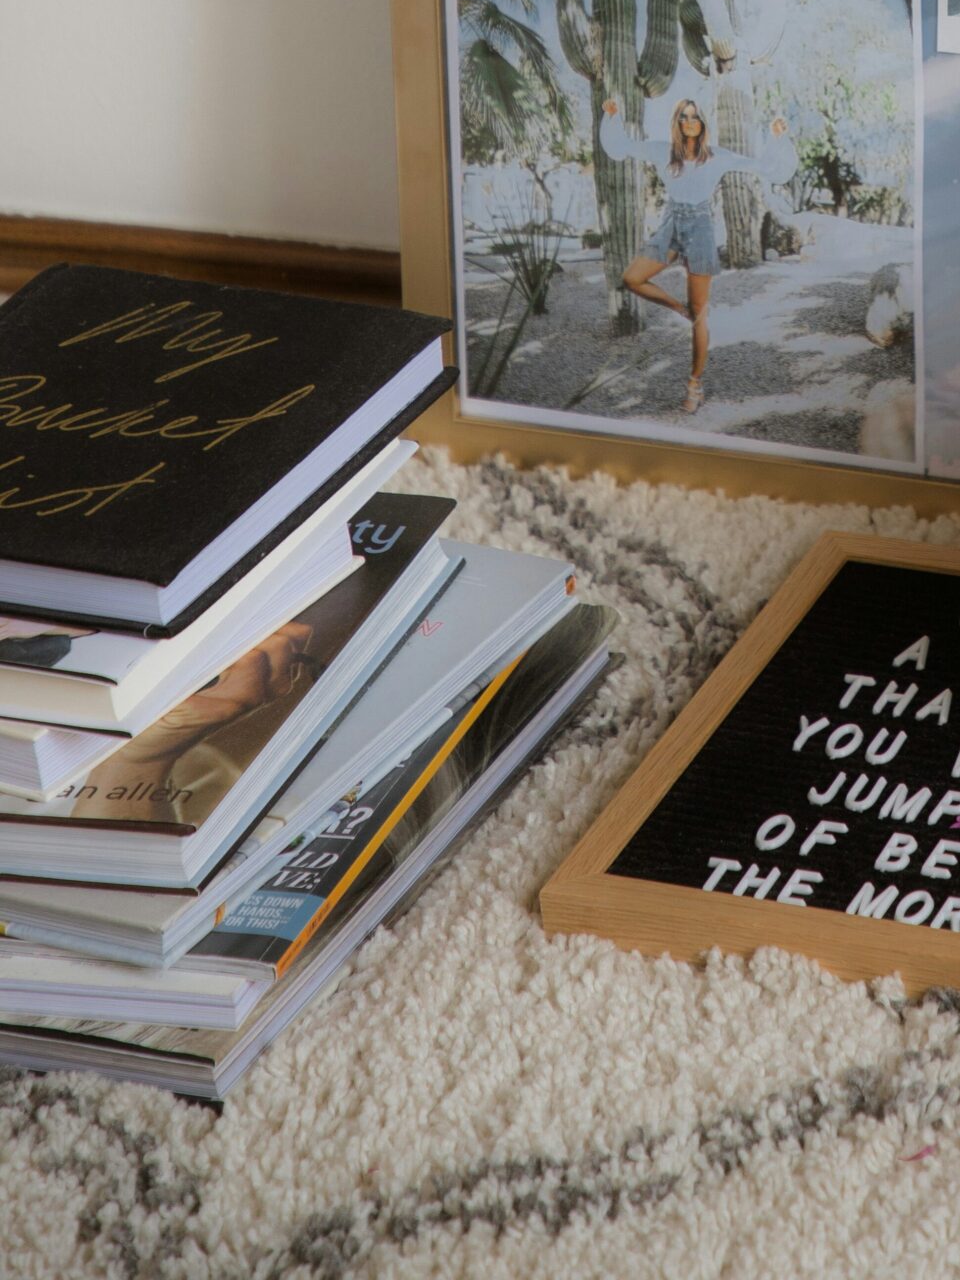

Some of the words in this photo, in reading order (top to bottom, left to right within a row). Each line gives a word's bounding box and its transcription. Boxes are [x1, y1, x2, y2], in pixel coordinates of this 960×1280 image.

[59, 301, 279, 383] My
[0, 456, 166, 517] ist
[352, 519, 406, 554] ty
[892, 635, 930, 671] A
[792, 715, 907, 766] YOU
[106, 782, 193, 803] allen
[755, 814, 849, 856] OF
[287, 851, 339, 869] LD
[272, 870, 321, 889] VE:
[702, 856, 824, 907] THE
[263, 896, 305, 909] DOWN
[225, 916, 246, 927] OR
